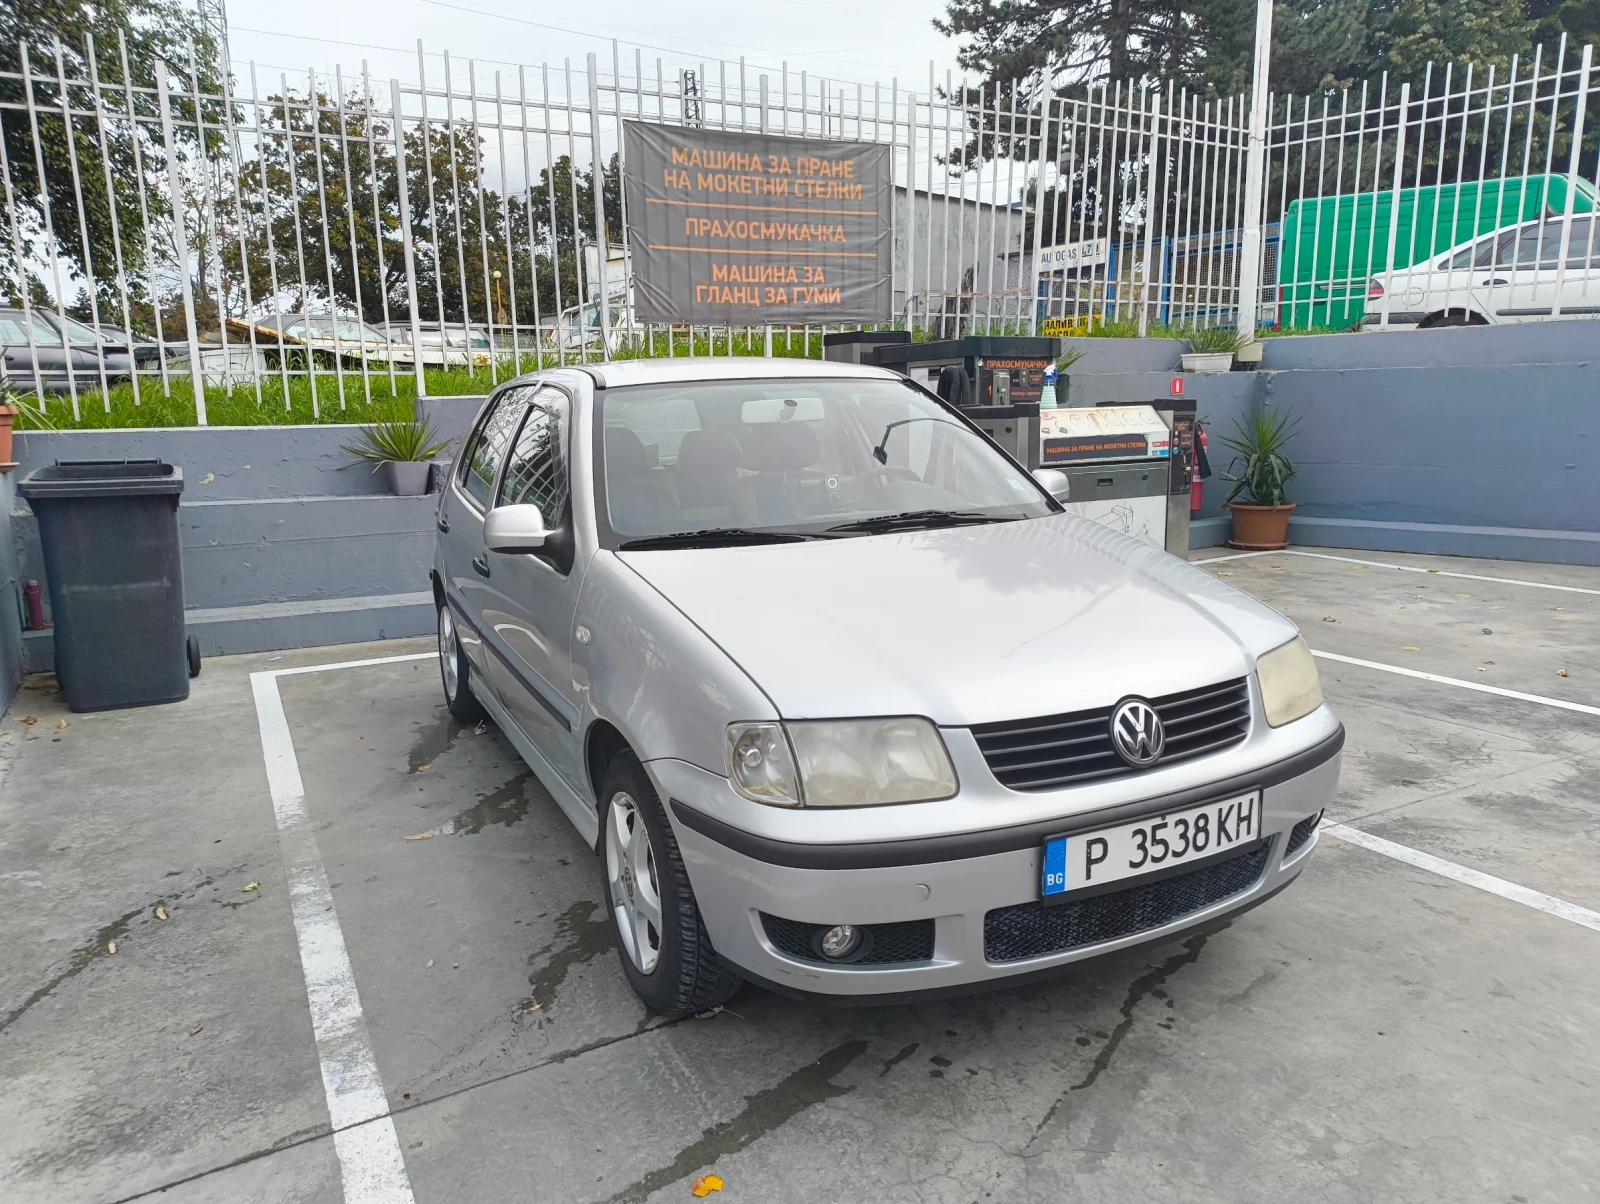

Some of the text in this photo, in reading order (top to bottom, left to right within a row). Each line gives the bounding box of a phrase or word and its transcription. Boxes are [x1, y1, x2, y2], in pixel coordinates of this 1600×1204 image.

[671, 146, 855, 179] МАШИНА ЗА ПРАНЕ
[663, 168, 863, 200] НА МОКЕТНИ СТЕЛКИ
[685, 217, 846, 242] ПРАХОСМУКАЧКА
[1041, 248, 1077, 264] AUOGAS
[712, 263, 826, 284] МАШИНА ЗА
[696, 285, 841, 307] ГЛАНЦ ЗА ГУМИ
[987, 360, 1048, 368] ПРАХОСМУКАЧКА
[1046, 872, 1064, 887] BG
